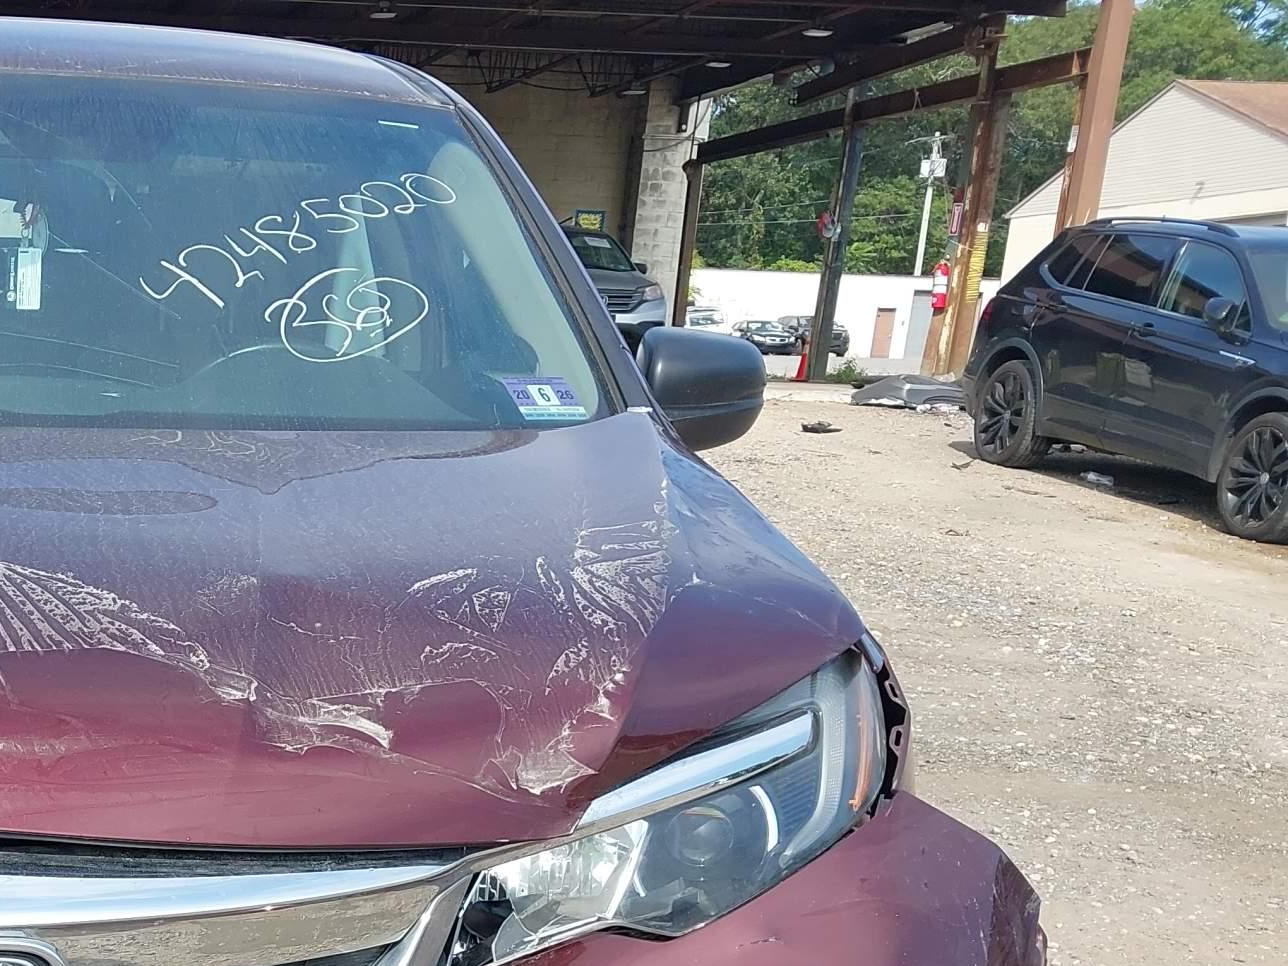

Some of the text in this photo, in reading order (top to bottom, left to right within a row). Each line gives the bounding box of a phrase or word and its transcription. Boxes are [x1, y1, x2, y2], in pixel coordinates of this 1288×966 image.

[139, 173, 457, 309] 42485020
[513, 387, 574, 402] 20 6 26
